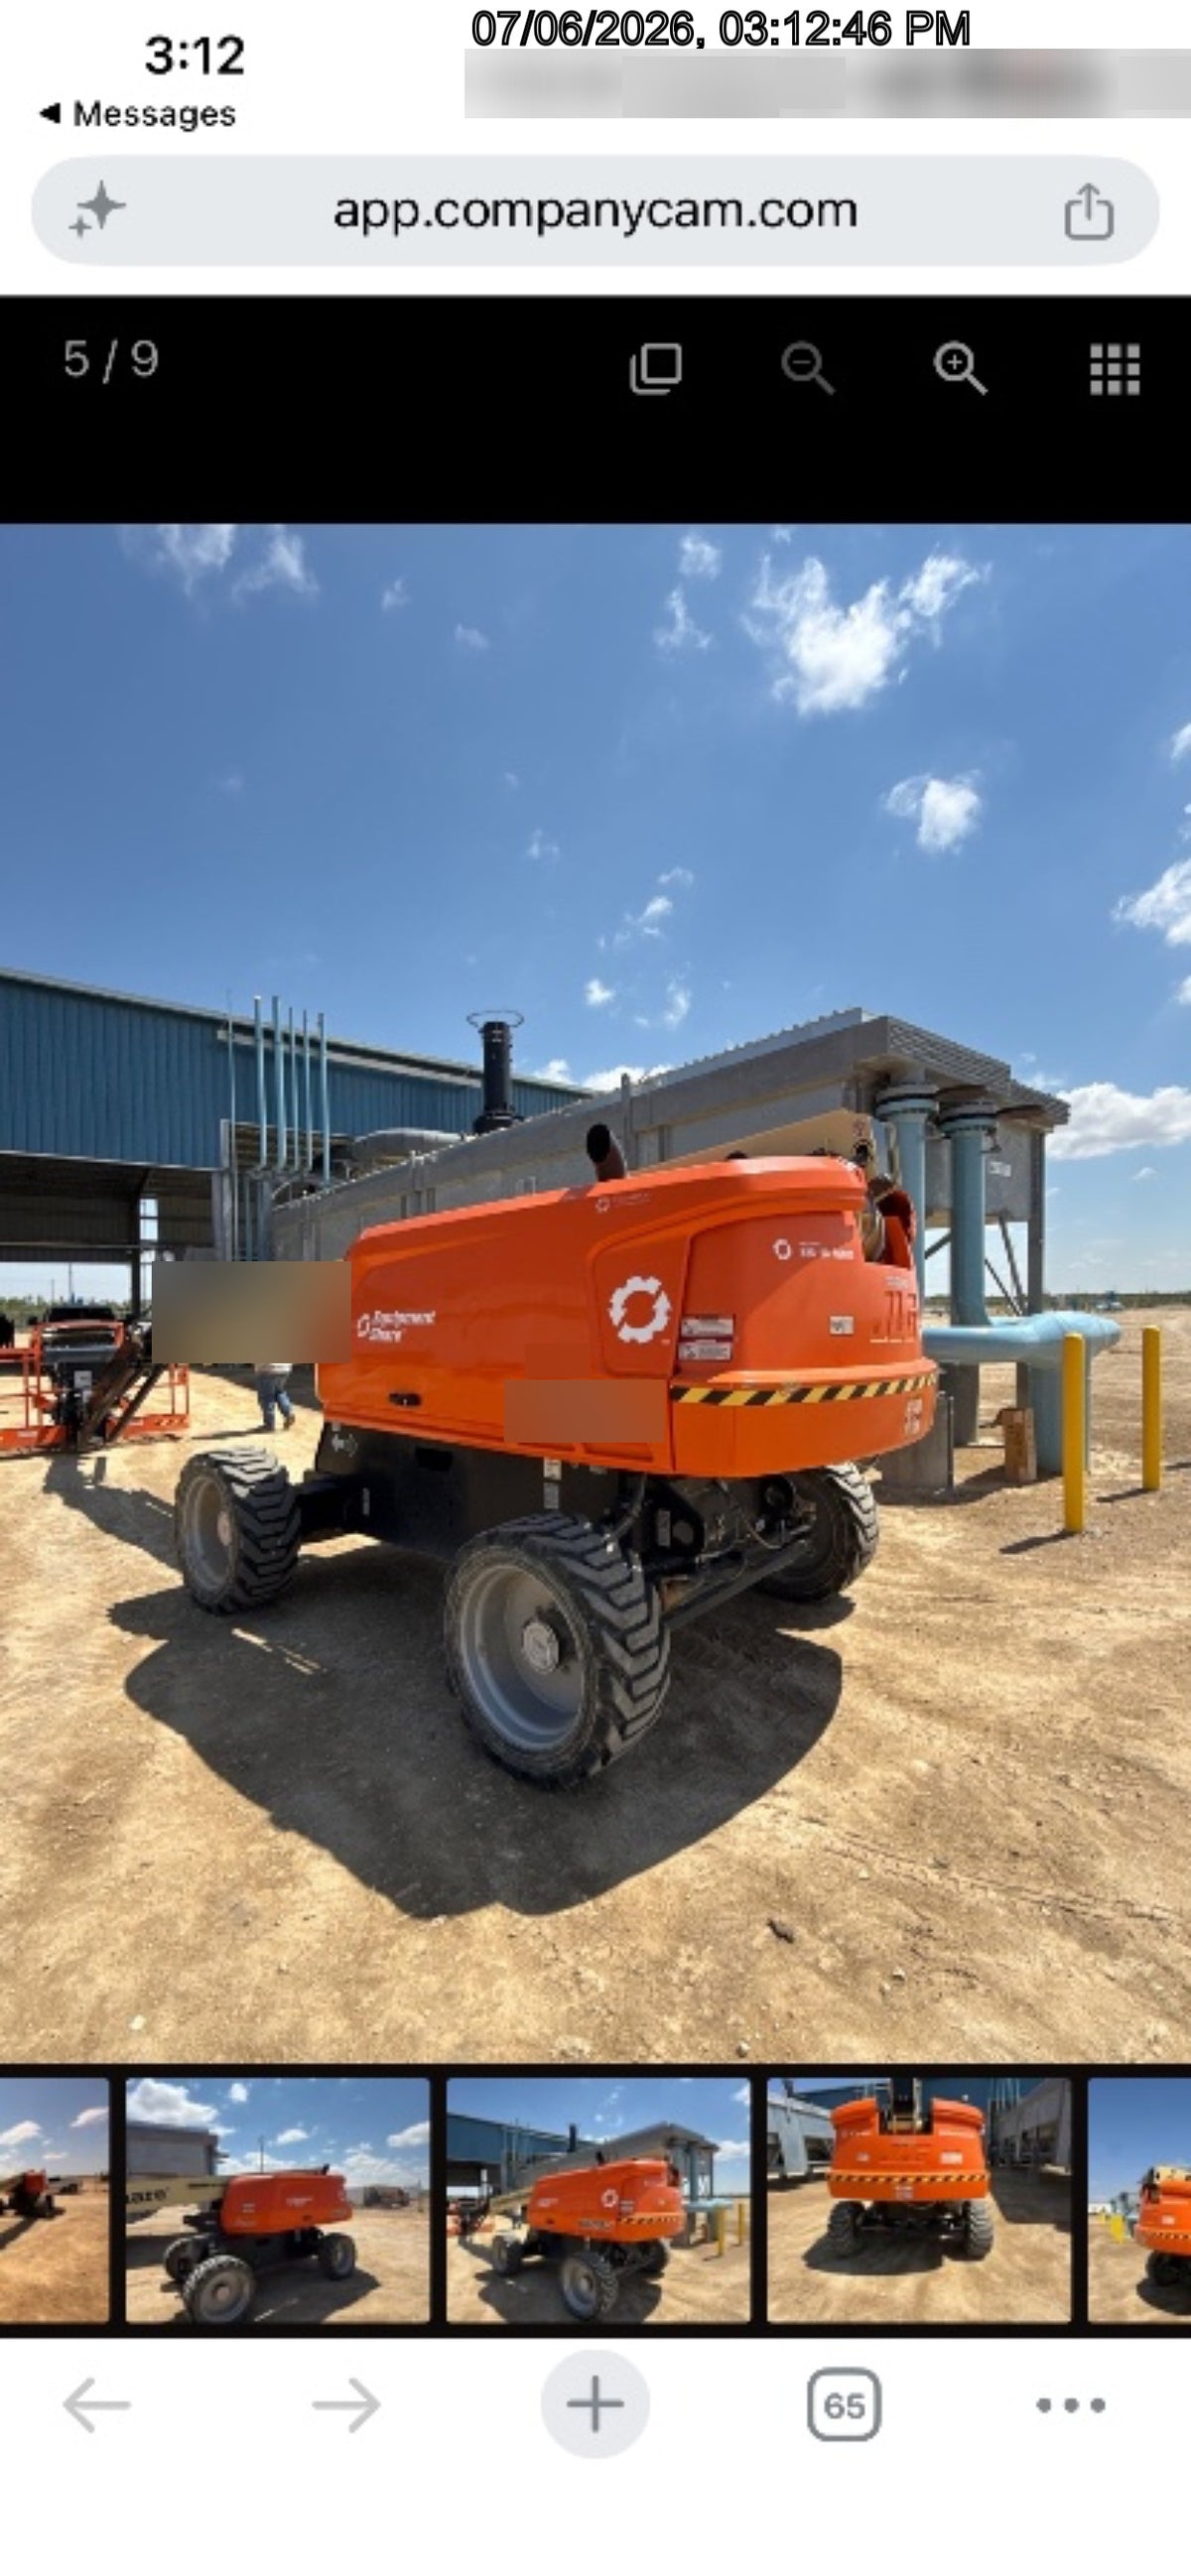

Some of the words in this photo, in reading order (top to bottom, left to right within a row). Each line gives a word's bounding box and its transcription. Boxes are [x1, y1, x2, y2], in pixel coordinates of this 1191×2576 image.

[145, 35, 244, 75] 3:12
[75, 101, 236, 133] Messages
[333, 198, 858, 238] app.companycam.com
[65, 339, 89, 377] 5
[131, 339, 159, 377] 9
[824, 2392, 865, 2419] 65
